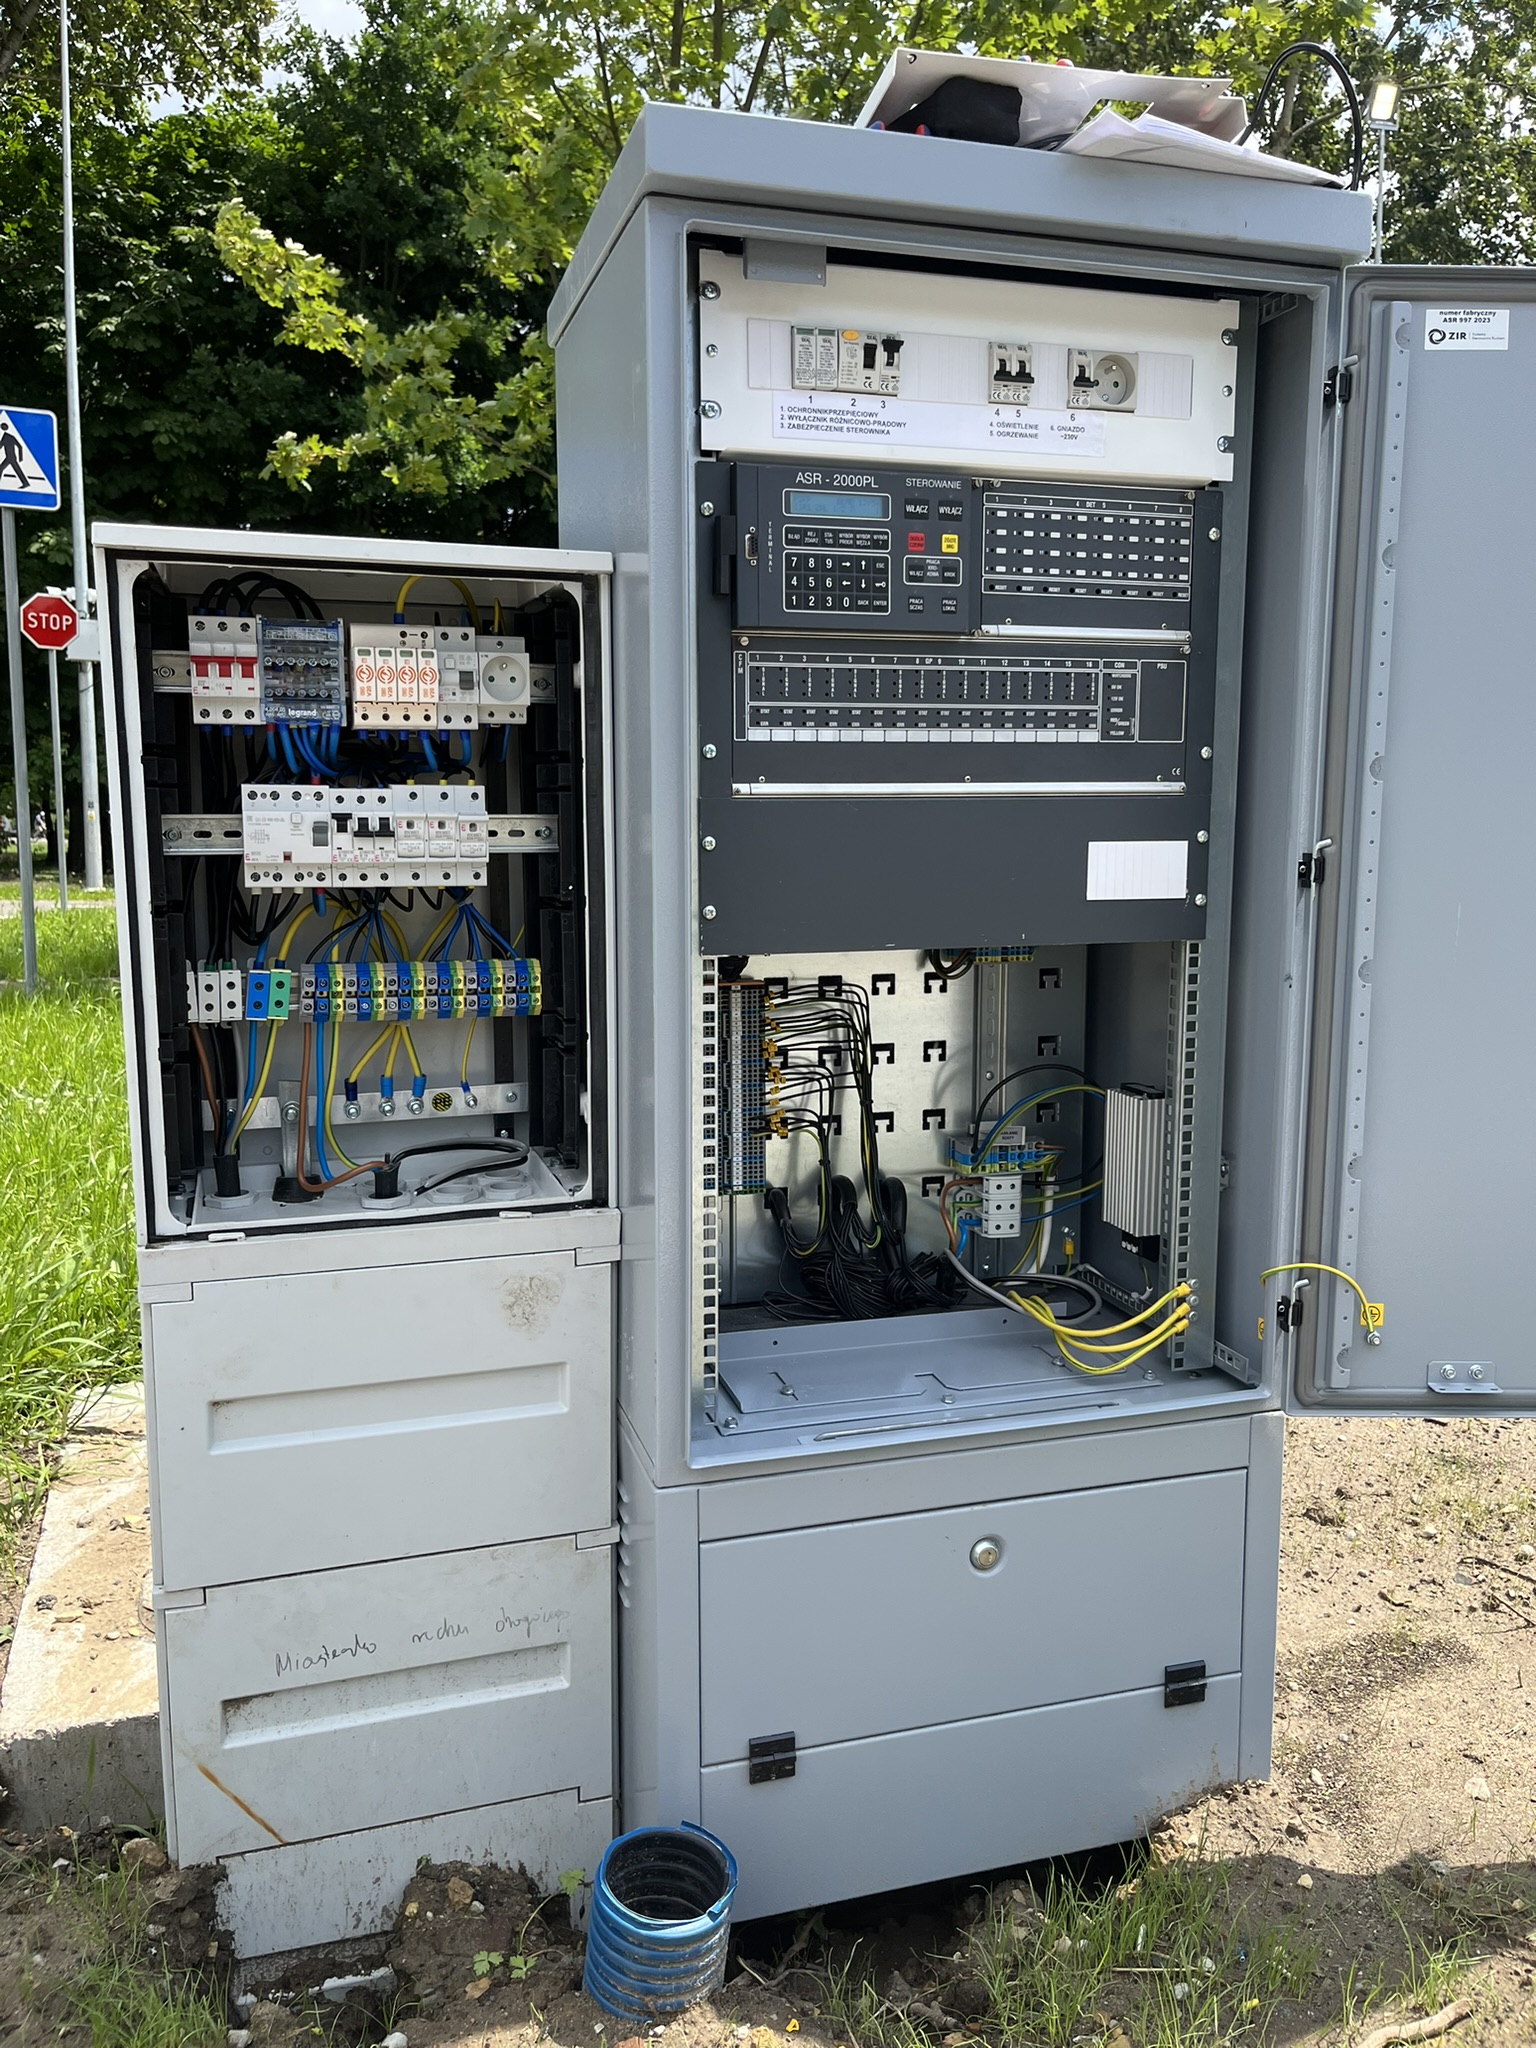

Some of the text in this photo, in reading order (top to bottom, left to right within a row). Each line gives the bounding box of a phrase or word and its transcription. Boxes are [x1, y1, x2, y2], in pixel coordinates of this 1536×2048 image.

[1448, 332, 1467, 340] ZIR
[808, 395, 813, 404] 1
[851, 398, 857, 407] 2
[880, 400, 886, 409] 3
[787, 406, 879, 419] OCHRONNIKPRZEPIĘCIOWY
[994, 408, 1000, 417] 4
[1016, 409, 1021, 418] 5
[1070, 413, 1076, 422] 6
[787, 414, 828, 424] WYŁĄCZNIK
[829, 416, 907, 428] RÓŻNICOWO-PRĄDOWY
[996, 421, 1039, 431] OŚWIETLENIE
[787, 423, 844, 433] ZABEZPIECZENIE
[846, 424, 891, 435] STEROWNIKA
[1057, 425, 1085, 433] GNIAZDO
[996, 431, 1039, 439] OGRZEWANIE
[796, 472, 822, 485] ASR
[833, 474, 879, 488] 2000PL
[905, 478, 962, 490] STEROWANIE
[905, 504, 928, 514] WŁĄCZ
[938, 506, 963, 516] WYŁĄCZ
[791, 557, 797, 568] 7
[808, 557, 815, 568] 8
[826, 558, 832, 569] 9
[791, 576, 797, 586] 4
[808, 577, 815, 587] 5
[826, 577, 832, 588] 6
[791, 595, 796, 606] 1
[808, 596, 815, 607] 2
[826, 596, 832, 607] 3
[843, 597, 850, 608] 0
[27, 612, 73, 631] STOP
[287, 707, 318, 719] legrand
